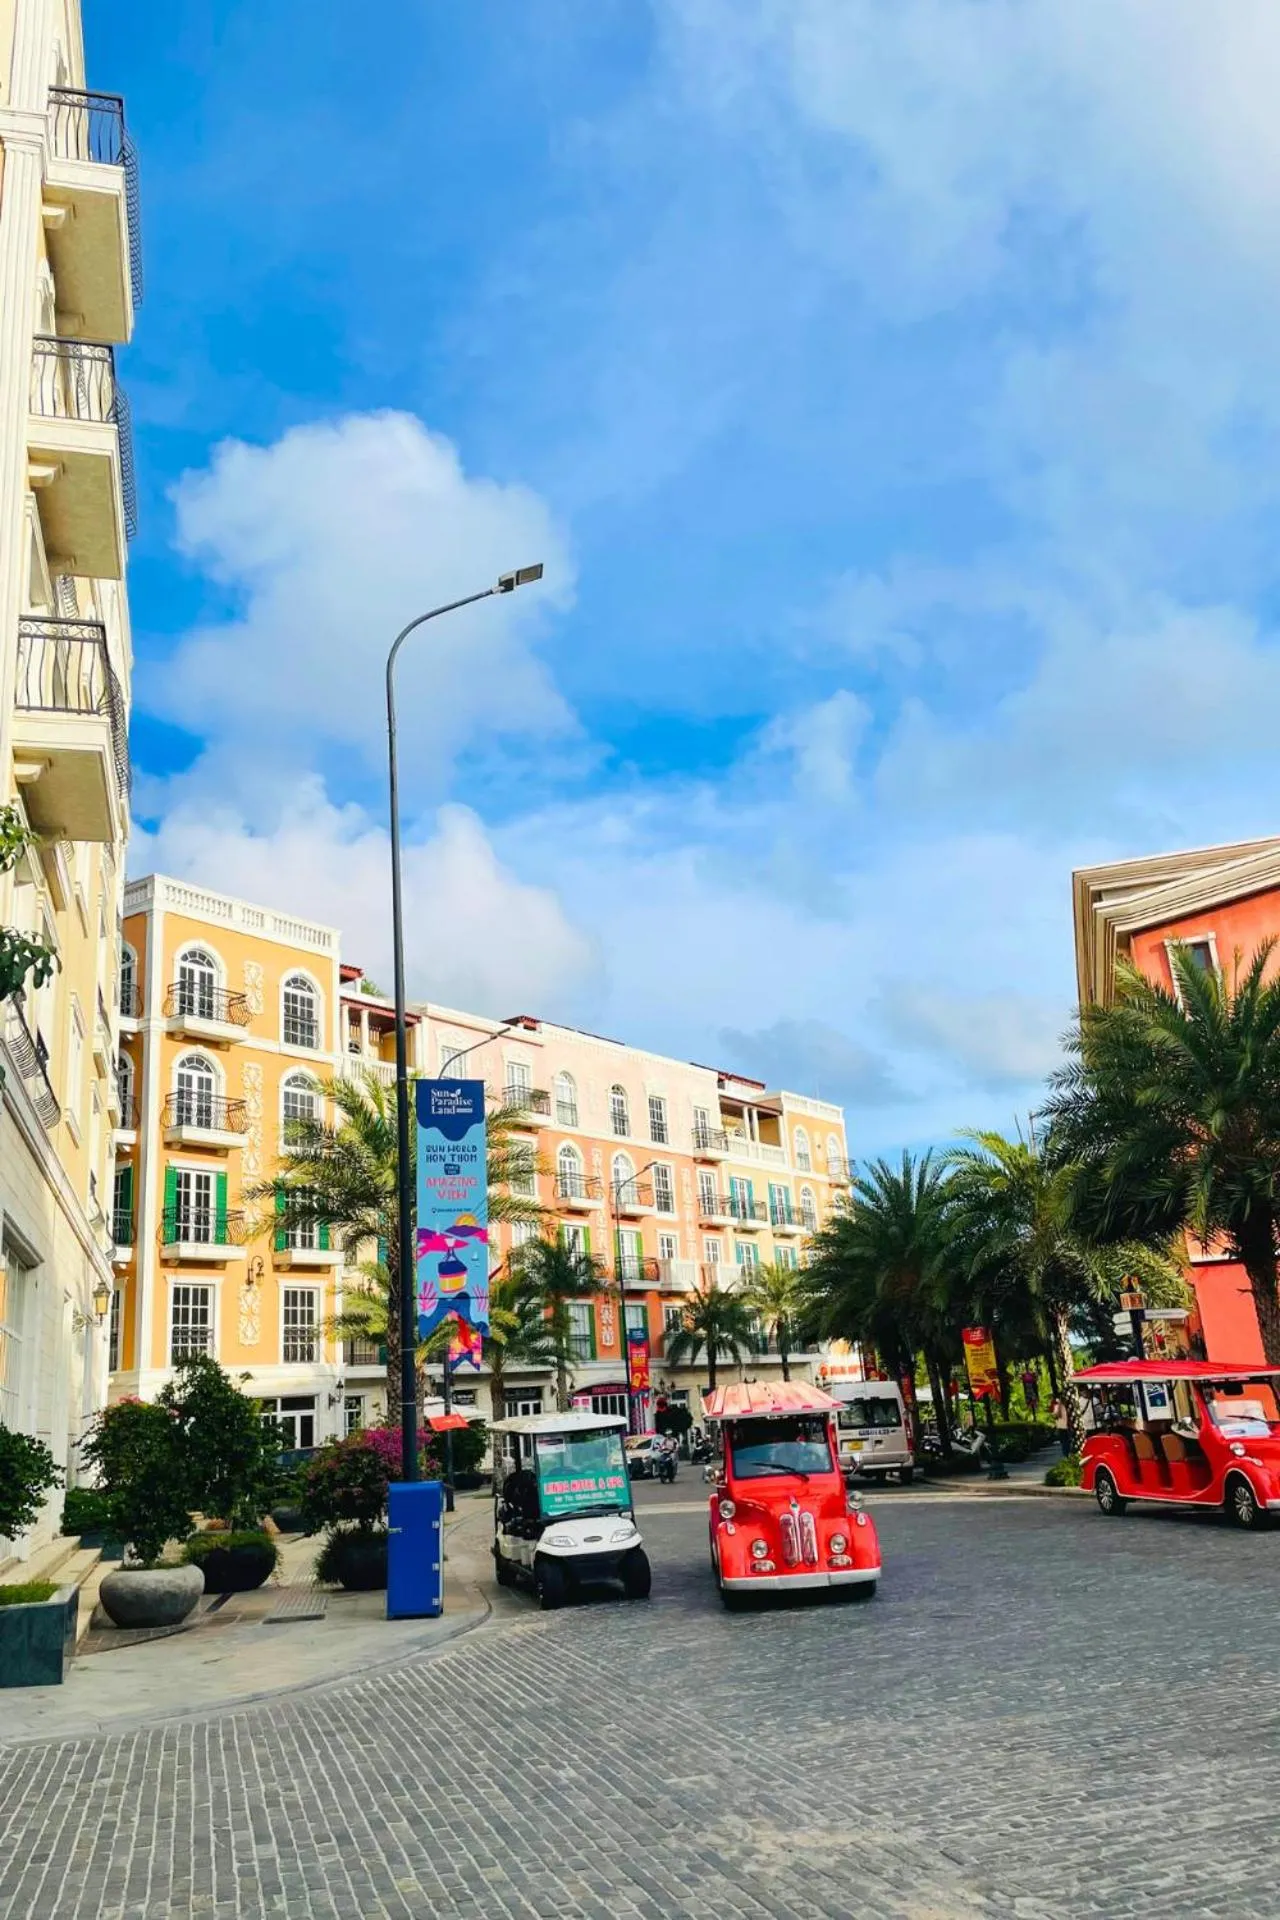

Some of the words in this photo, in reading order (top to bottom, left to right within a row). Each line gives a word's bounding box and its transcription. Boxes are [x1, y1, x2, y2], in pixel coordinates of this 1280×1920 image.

[431, 1088, 449, 1098] Sun
[431, 1097, 473, 1106] Paradise
[431, 1105, 455, 1115] Land
[426, 1144, 444, 1153] SUN
[448, 1144, 477, 1153] WORLD
[426, 1153, 446, 1163] HON
[449, 1153, 477, 1163] THOM
[426, 1177, 477, 1188] AMAZING
[437, 1189, 467, 1200] VIEW
